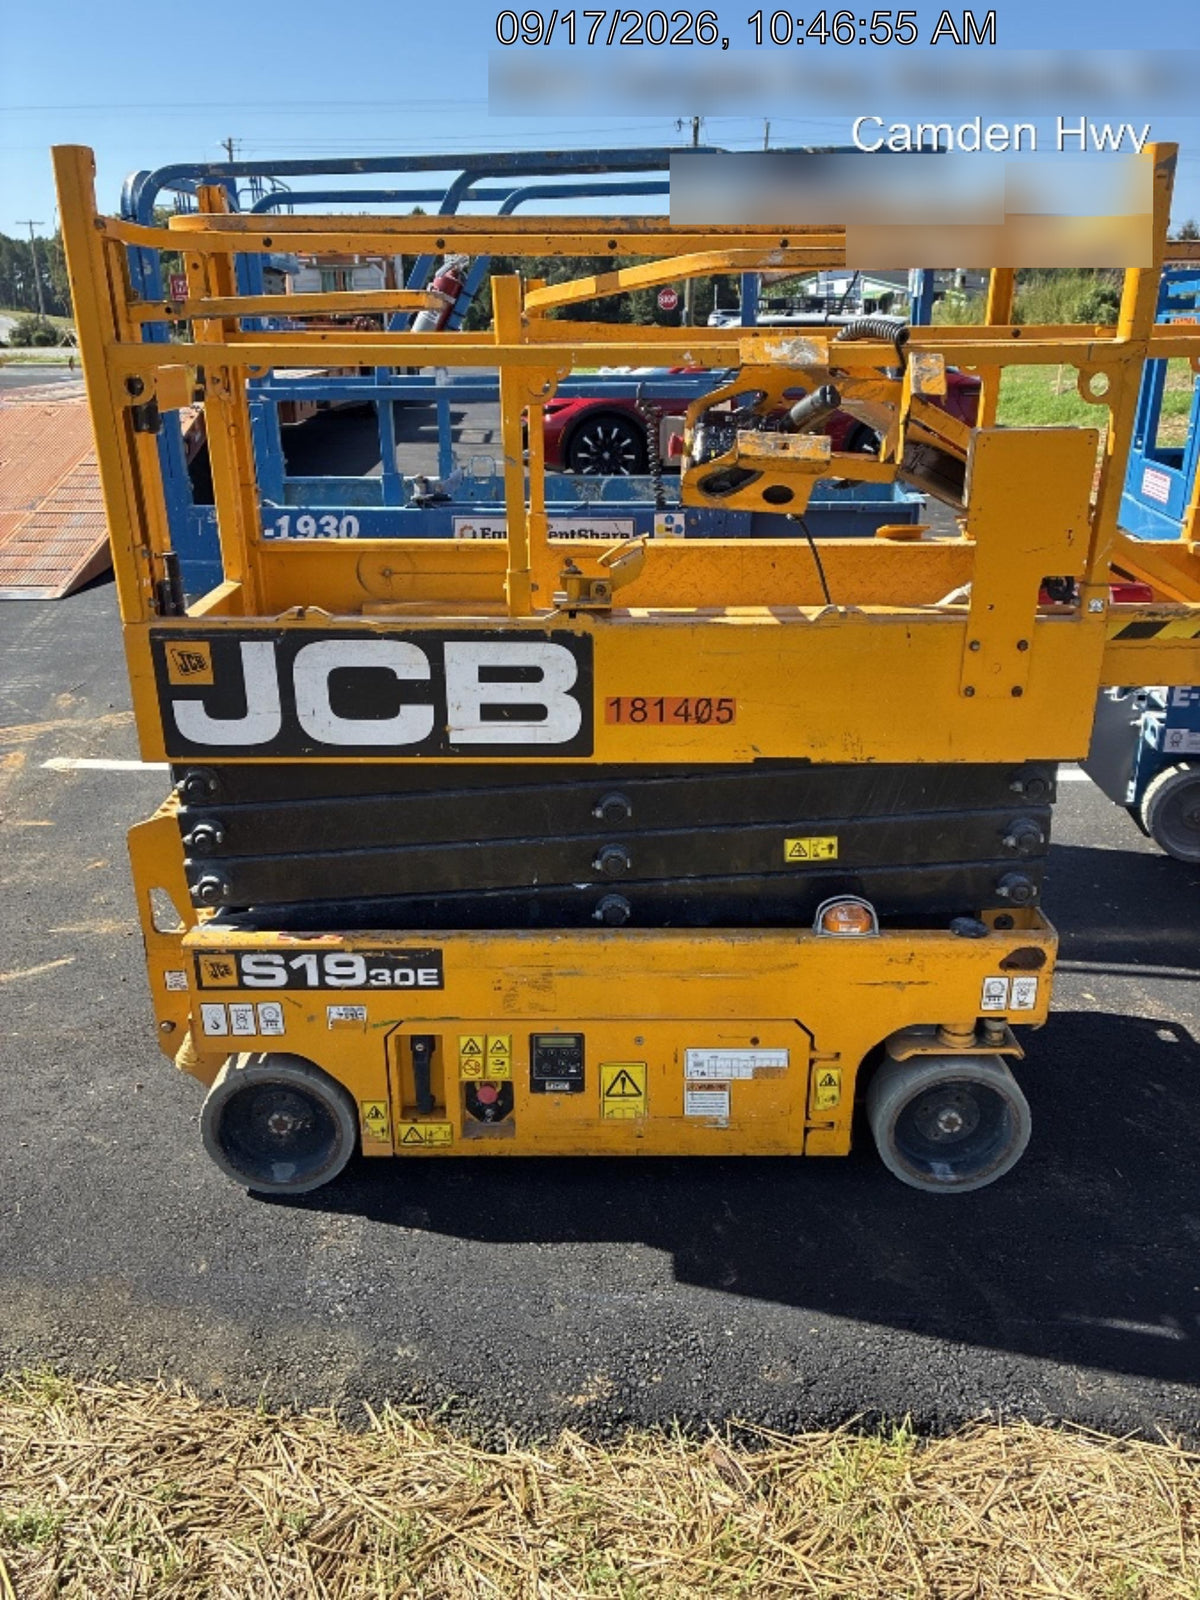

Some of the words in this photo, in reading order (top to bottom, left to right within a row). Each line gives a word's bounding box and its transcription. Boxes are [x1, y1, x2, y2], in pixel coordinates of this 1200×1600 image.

[171, 640, 582, 746] JCB
[1172, 686, 1200, 707] E-
[608, 697, 734, 725] 181405
